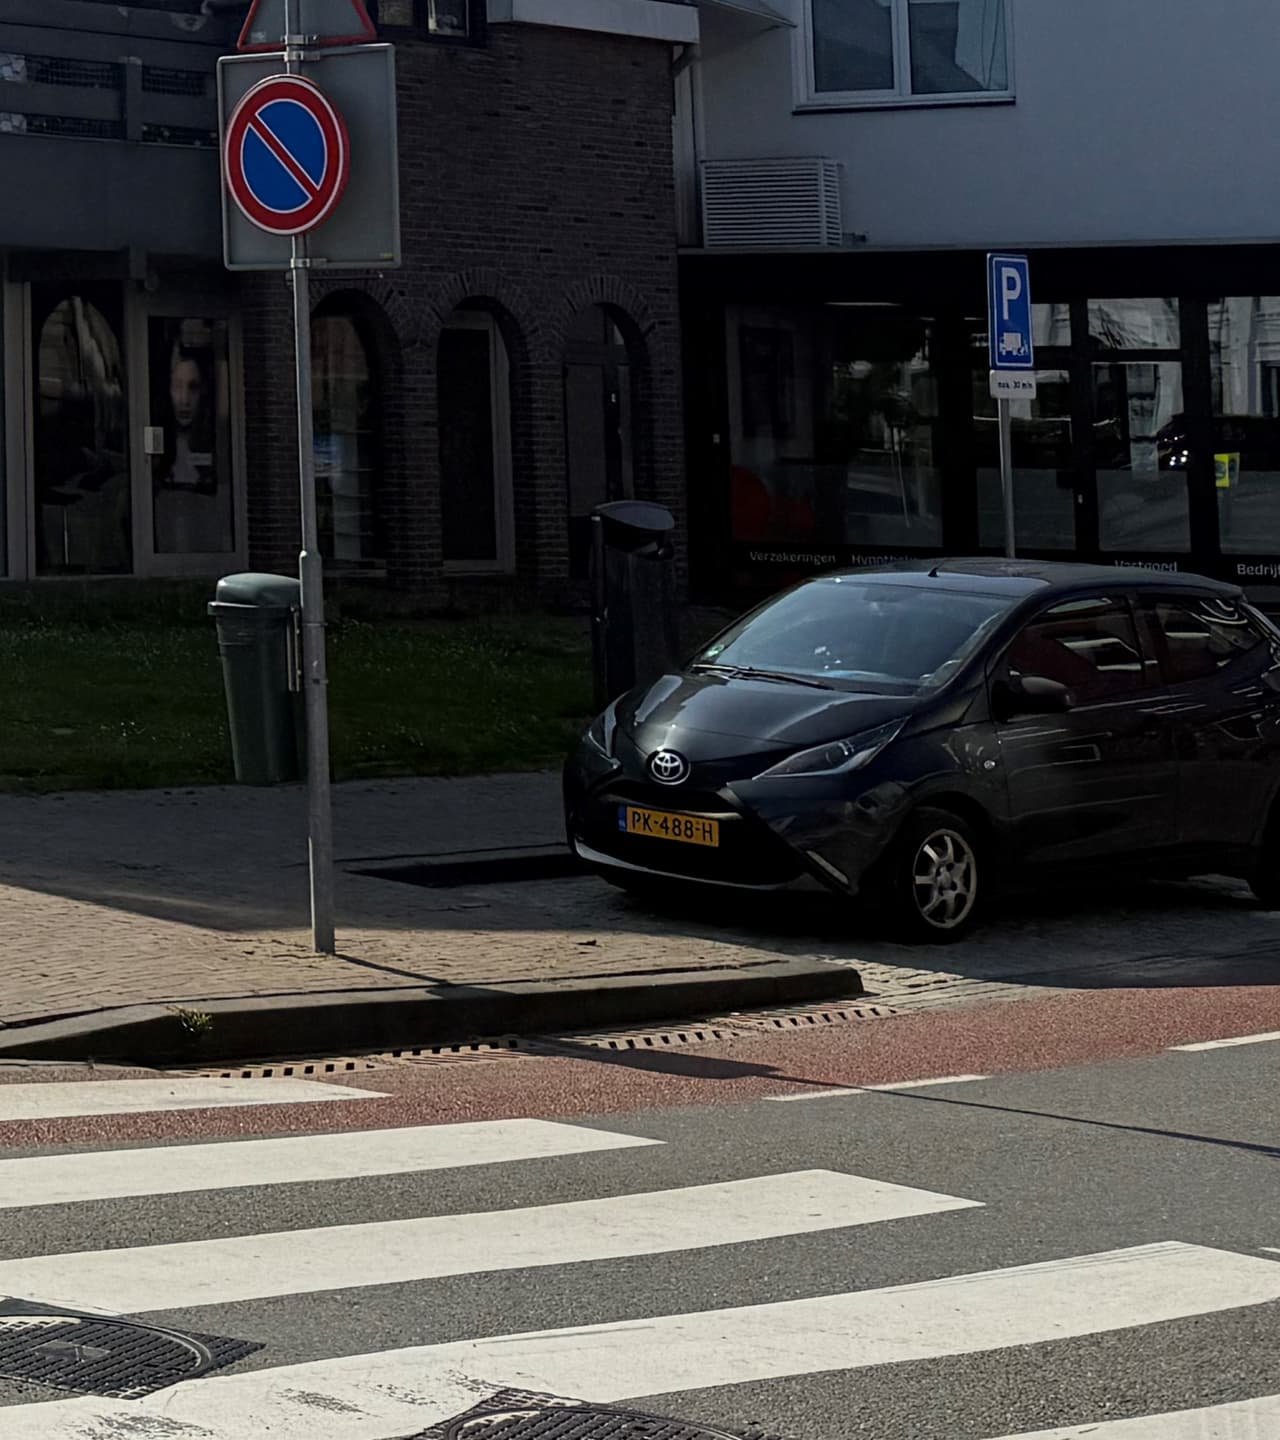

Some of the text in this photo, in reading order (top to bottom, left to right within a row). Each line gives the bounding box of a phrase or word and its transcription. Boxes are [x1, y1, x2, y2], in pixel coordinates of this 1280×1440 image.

[1001, 266, 1022, 320] P
[749, 550, 837, 565] Verzekeringen
[1236, 563, 1280, 579] Bedrij
[631, 811, 714, 842] PK-488-H
